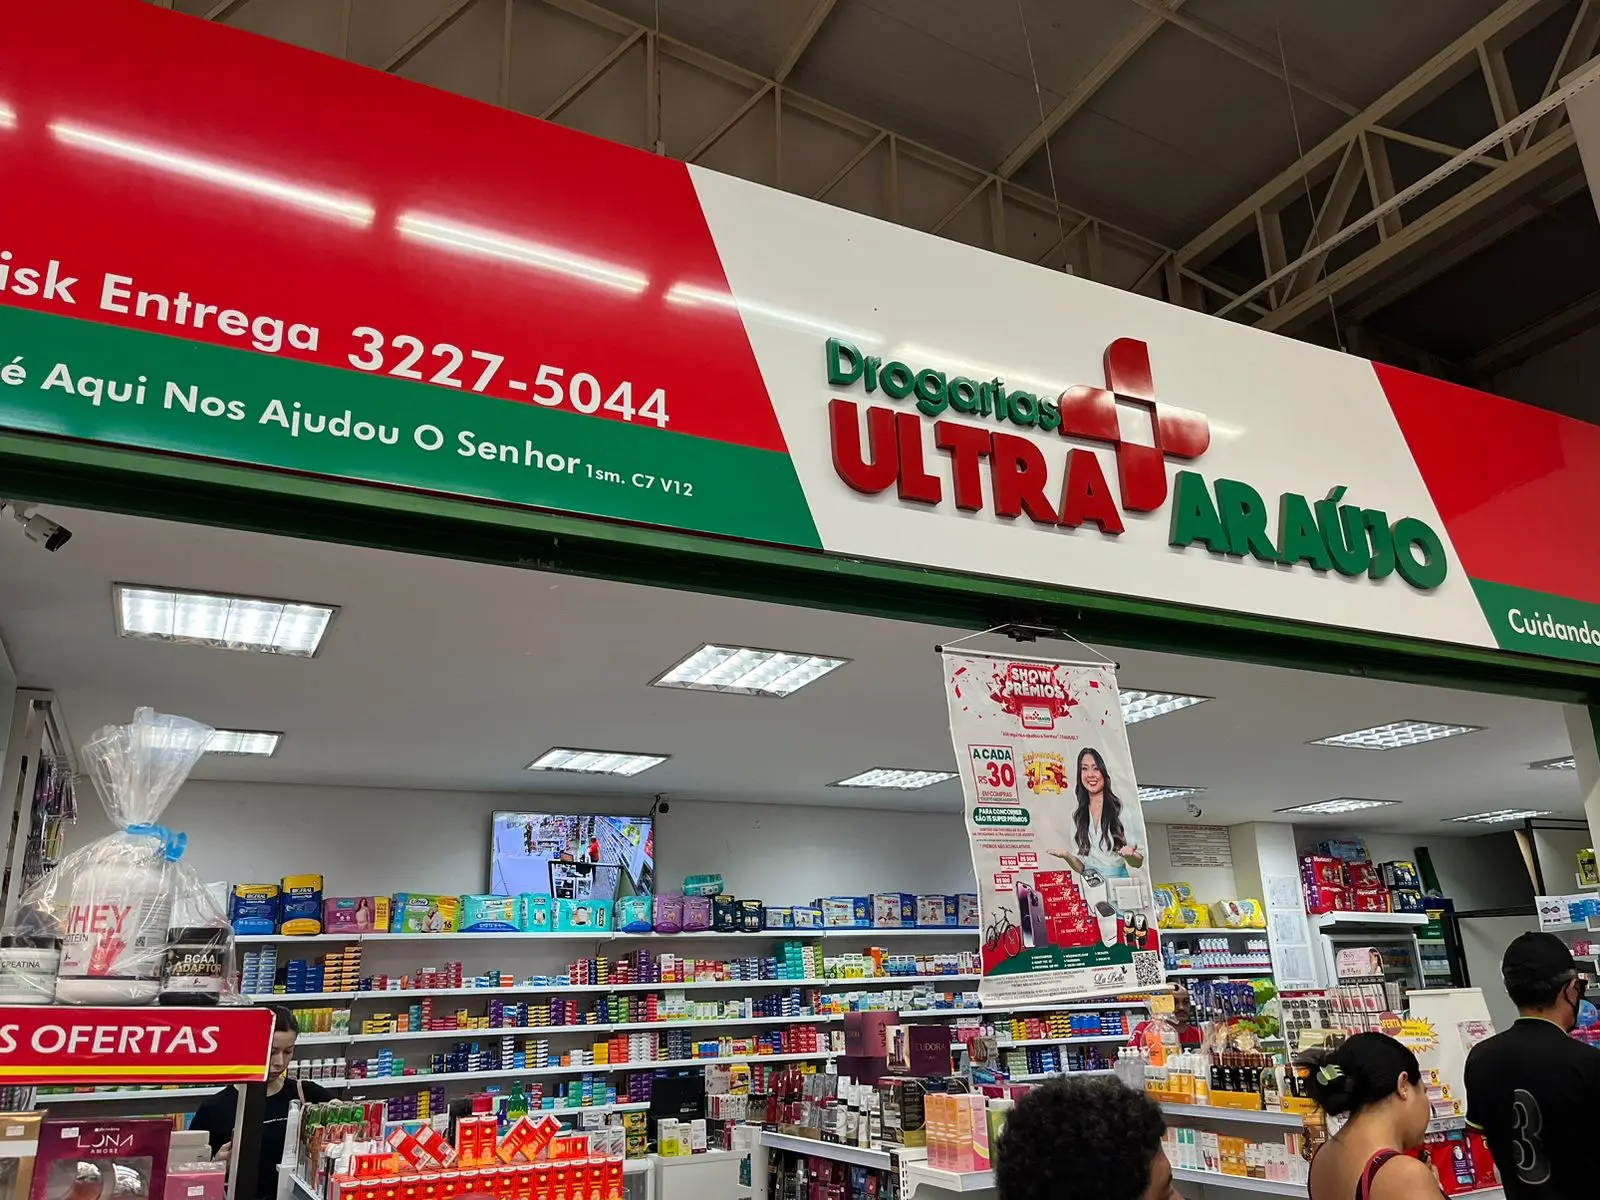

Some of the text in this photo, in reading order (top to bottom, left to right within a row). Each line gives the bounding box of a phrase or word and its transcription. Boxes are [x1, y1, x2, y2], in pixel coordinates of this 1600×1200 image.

[100, 273, 319, 353] Entrega
[348, 326, 670, 428] 3227-5044
[826, 336, 1061, 431] Drogarias
[0, 356, 27, 386] é
[40, 363, 148, 406] Aqui
[163, 381, 246, 421] Nos
[258, 399, 399, 445] Ajudou
[413, 424, 444, 451] O
[457, 430, 581, 474] Senhor
[631, 473, 655, 489] C7
[660, 478, 693, 497] V12
[828, 399, 1448, 590] ULTRA ARAÚJO
[1011, 667, 1051, 684] SHOW
[1004, 681, 1065, 699] PRÊMIOS
[973, 749, 1012, 761] A CADA
[986, 761, 1015, 788] 30
[64, 934, 89, 943] OTEIN
[1, 960, 41, 968] CREATINA
[184, 954, 215, 964] BCAA
[0, 1025, 220, 1054] S OFERTAS
